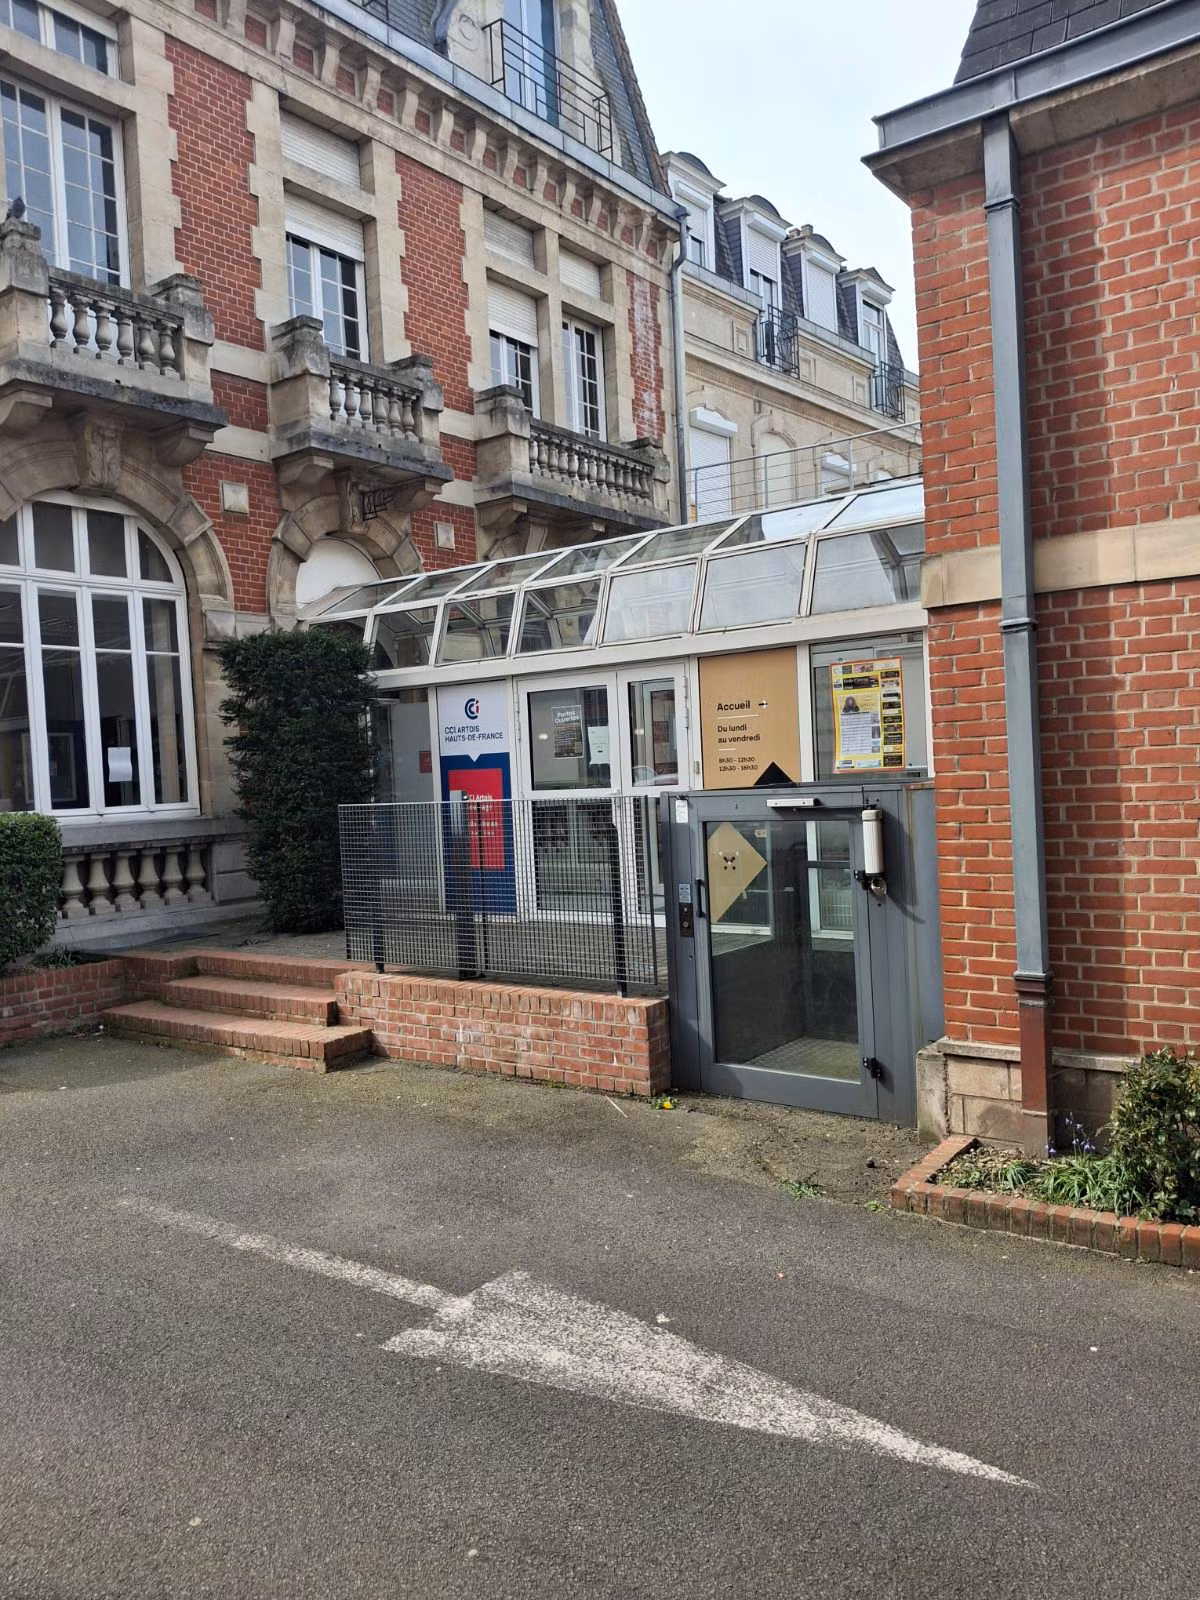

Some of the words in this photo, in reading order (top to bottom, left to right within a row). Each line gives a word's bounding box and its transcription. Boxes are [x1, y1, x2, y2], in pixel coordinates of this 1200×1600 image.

[717, 700, 751, 711] Accueil
[444, 726, 456, 734] CCI
[457, 725, 480, 733] ARTOIS
[445, 732, 504, 742] HAUTS-DE-FRANCE
[728, 734, 761, 742] vendredi
